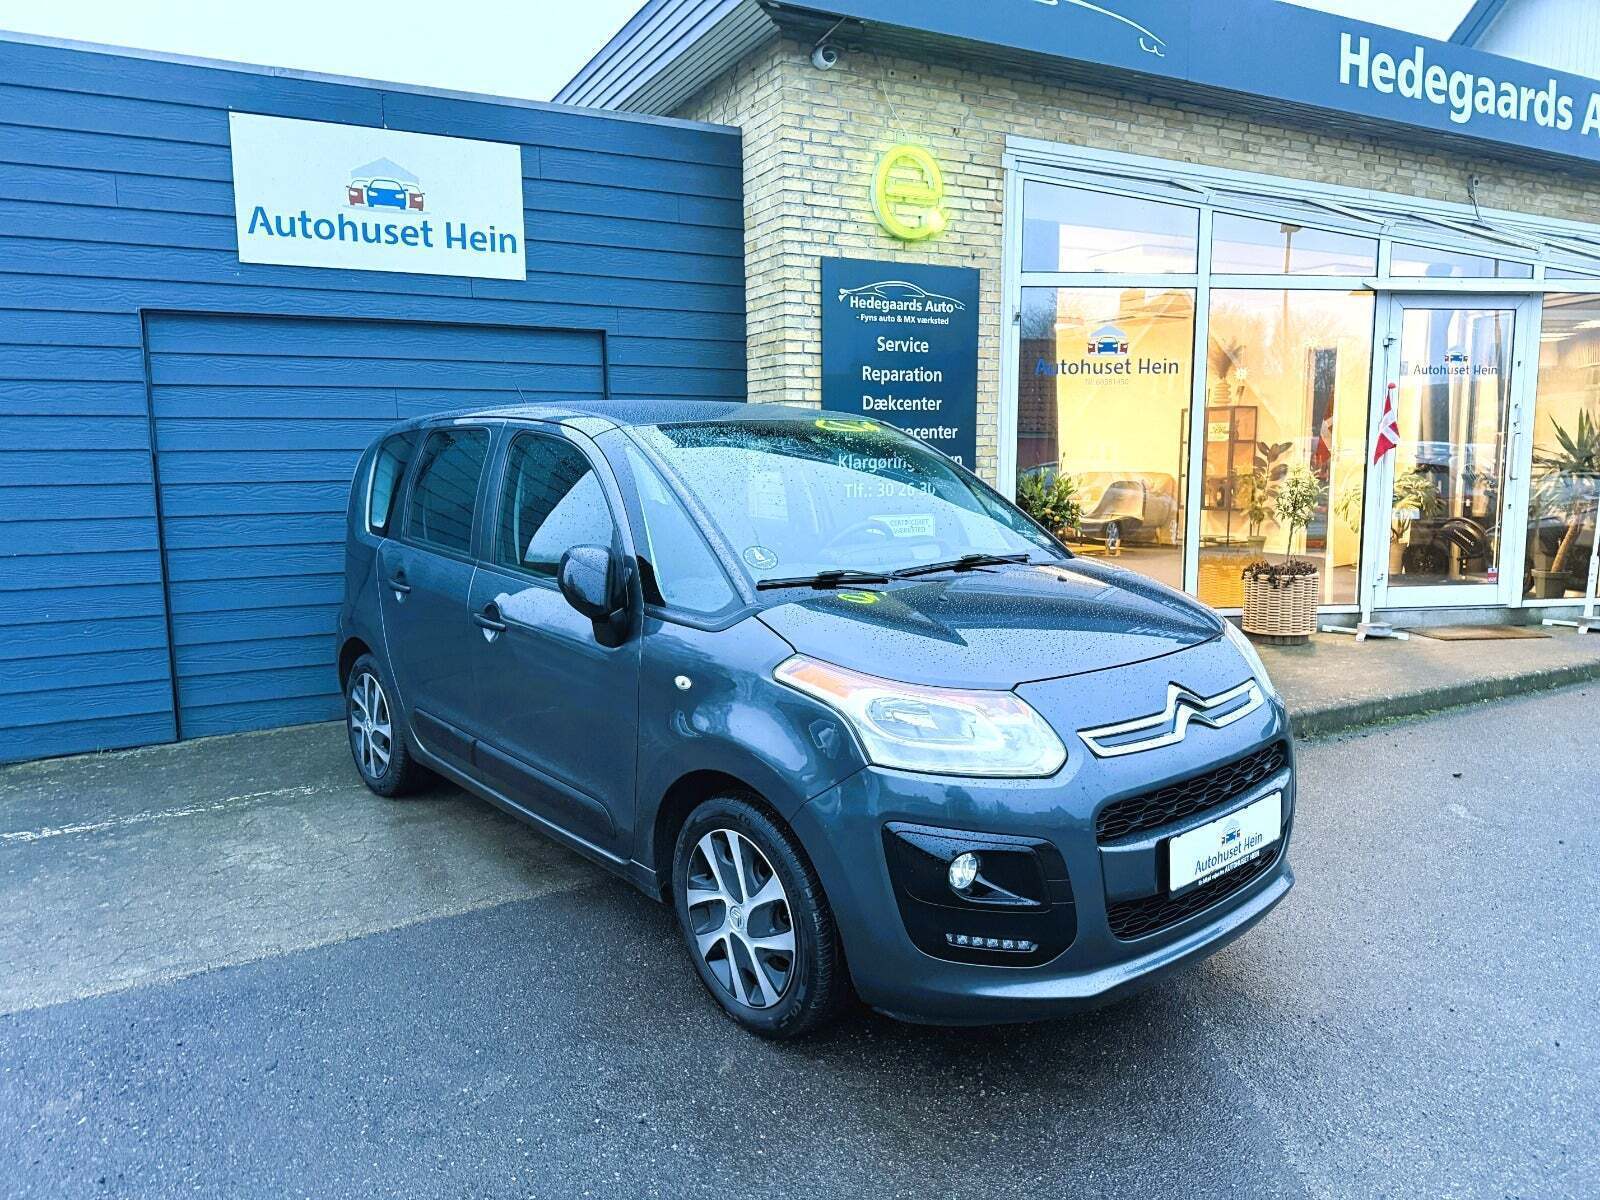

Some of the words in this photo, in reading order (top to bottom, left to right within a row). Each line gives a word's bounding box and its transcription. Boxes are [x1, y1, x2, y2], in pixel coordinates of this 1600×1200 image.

[1340, 32, 1573, 131] Hedegaards
[248, 206, 433, 248] Autohuset
[446, 222, 517, 253] Hein
[850, 295, 922, 313] Hedegaards
[925, 300, 954, 313] Auto
[861, 313, 877, 323] Fyns
[918, 317, 949, 325] værksted
[877, 336, 929, 353] Service
[1035, 357, 1131, 375] Autohuset
[1138, 358, 1179, 375] Hein
[1414, 363, 1469, 375] Autohuset
[1474, 364, 1498, 375] Hein
[862, 366, 942, 385] Reparation
[863, 395, 942, 411] Dækcenter
[1195, 840, 1241, 876] Autohuset
[1244, 832, 1262, 851] Hein
